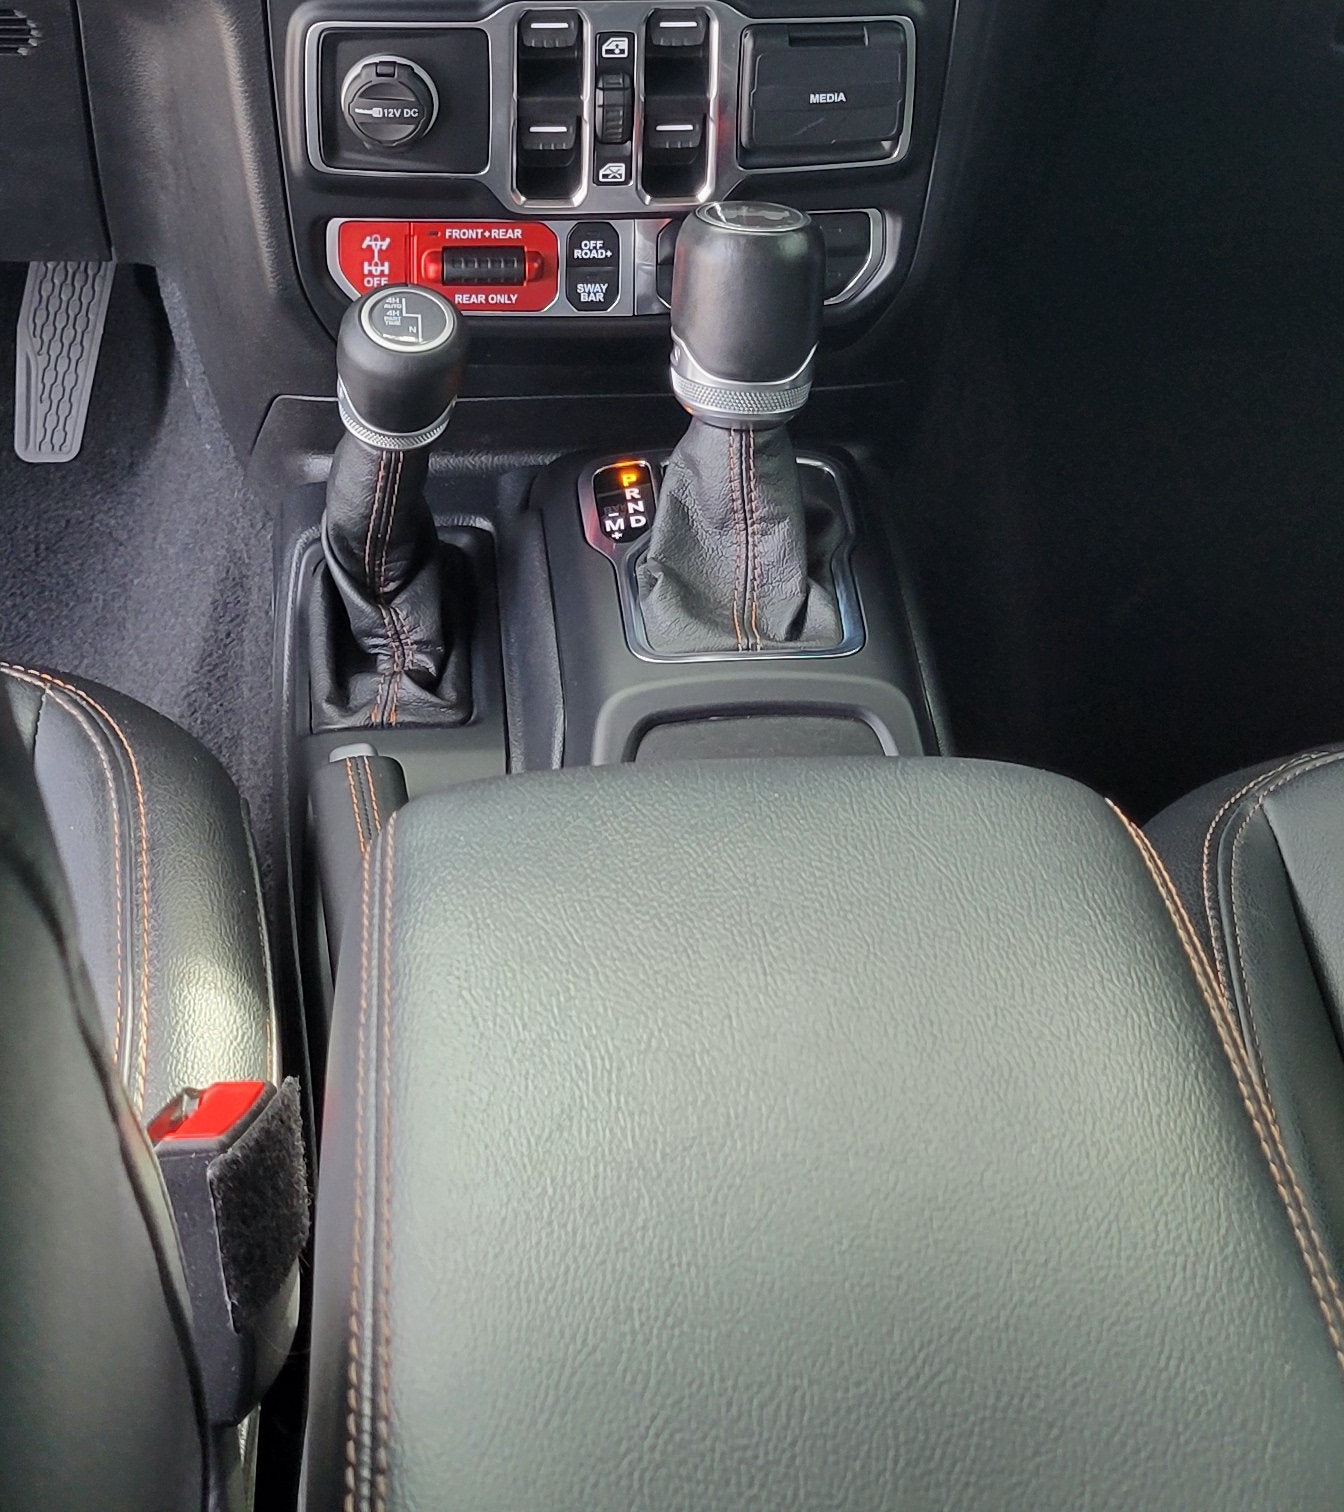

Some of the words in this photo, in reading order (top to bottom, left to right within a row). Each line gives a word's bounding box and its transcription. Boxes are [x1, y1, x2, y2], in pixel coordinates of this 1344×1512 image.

[809, 92, 847, 104] MEDIA
[383, 108, 402, 118] 12V
[403, 108, 419, 118] DC
[445, 228, 522, 239] FRONT+REAR
[580, 240, 604, 251] OFF
[573, 249, 613, 259] ROAD+
[363, 277, 389, 287] OFF
[576, 283, 608, 294] SWAY
[455, 293, 487, 304] REAR
[488, 293, 518, 305] ONLY
[580, 292, 605, 303] BAR
[408, 325, 417, 333] N
[622, 473, 637, 487] P
[624, 488, 641, 500] R
[627, 500, 645, 514] N
[604, 518, 625, 532] M
[629, 515, 647, 528] D
